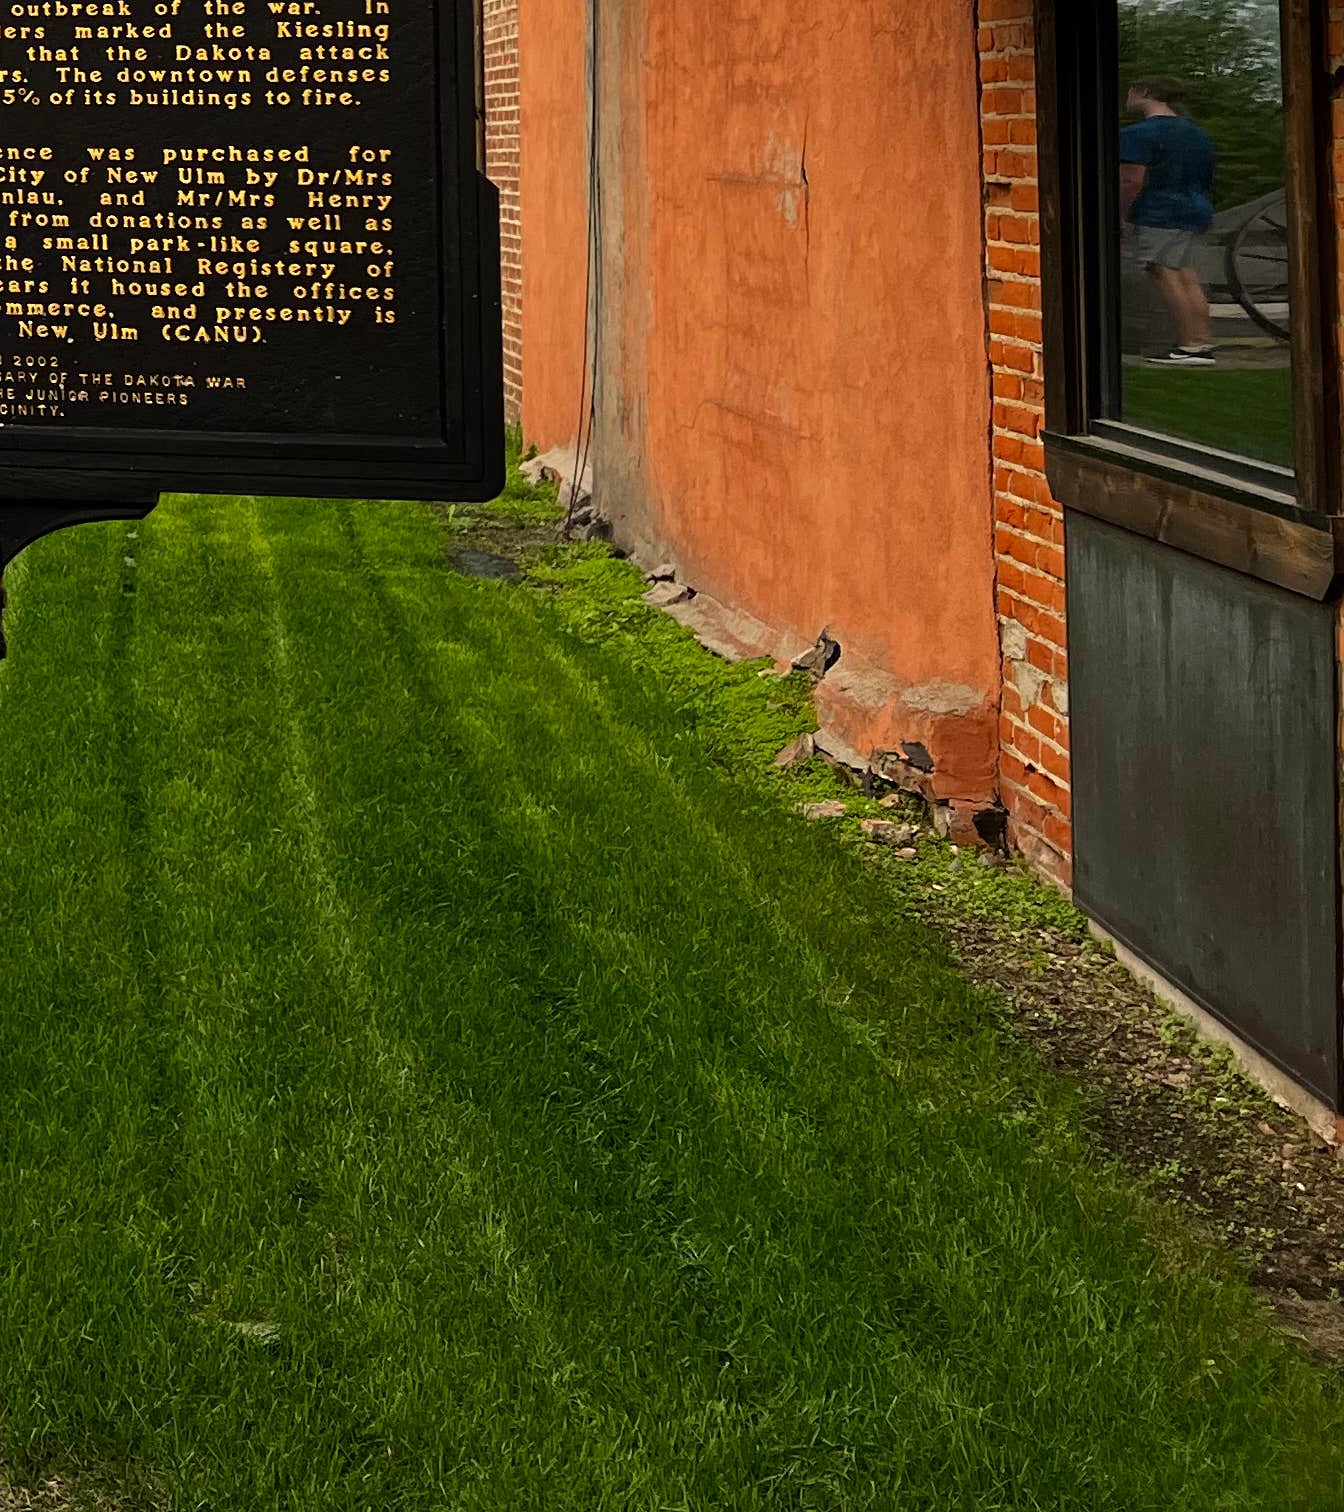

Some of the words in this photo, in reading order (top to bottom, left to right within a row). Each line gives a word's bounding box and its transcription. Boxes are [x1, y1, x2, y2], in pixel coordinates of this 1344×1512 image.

[10, 0, 132, 17] outbreak
[154, 0, 182, 16] of
[203, 0, 246, 16] the
[267, 1, 321, 16] war.
[74, 22, 172, 39] marked
[203, 22, 245, 39] the
[276, 20, 389, 42] Kiesling
[25, 45, 80, 62] that
[105, 45, 148, 62] the
[175, 43, 271, 61] Dakota
[299, 43, 390, 61] attack
[55, 66, 103, 83] The
[116, 67, 251, 83] downtown
[265, 65, 390, 83] defenses
[49, 88, 76, 105] of
[83, 89, 117, 106] its
[129, 88, 252, 110] buildings
[264, 89, 291, 106] to
[301, 88, 361, 106] fire.
[86, 147, 135, 161] was
[162, 145, 309, 165] purchased
[348, 145, 392, 163] for
[8, 209, 70, 227] from
[88, 211, 223, 230] donations
[241, 216, 268, 230] as
[286, 213, 341, 231] well
[364, 218, 393, 232] as
[60, 255, 173, 274] National
[197, 257, 336, 280] Registery
[366, 260, 394, 278] of
[70, 277, 90, 295] it
[111, 278, 206, 297] housed
[224, 281, 269, 299] the
[293, 281, 394, 301] offices
[13, 355, 59, 368] 2002
[49, 372, 69, 385] OF
[78, 372, 113, 386] THE
[124, 374, 196, 388] DAKOTA
[205, 376, 246, 389] WAR
[25, 387, 89, 402] JUNIOR
[98, 390, 188, 406] PIONEERS
